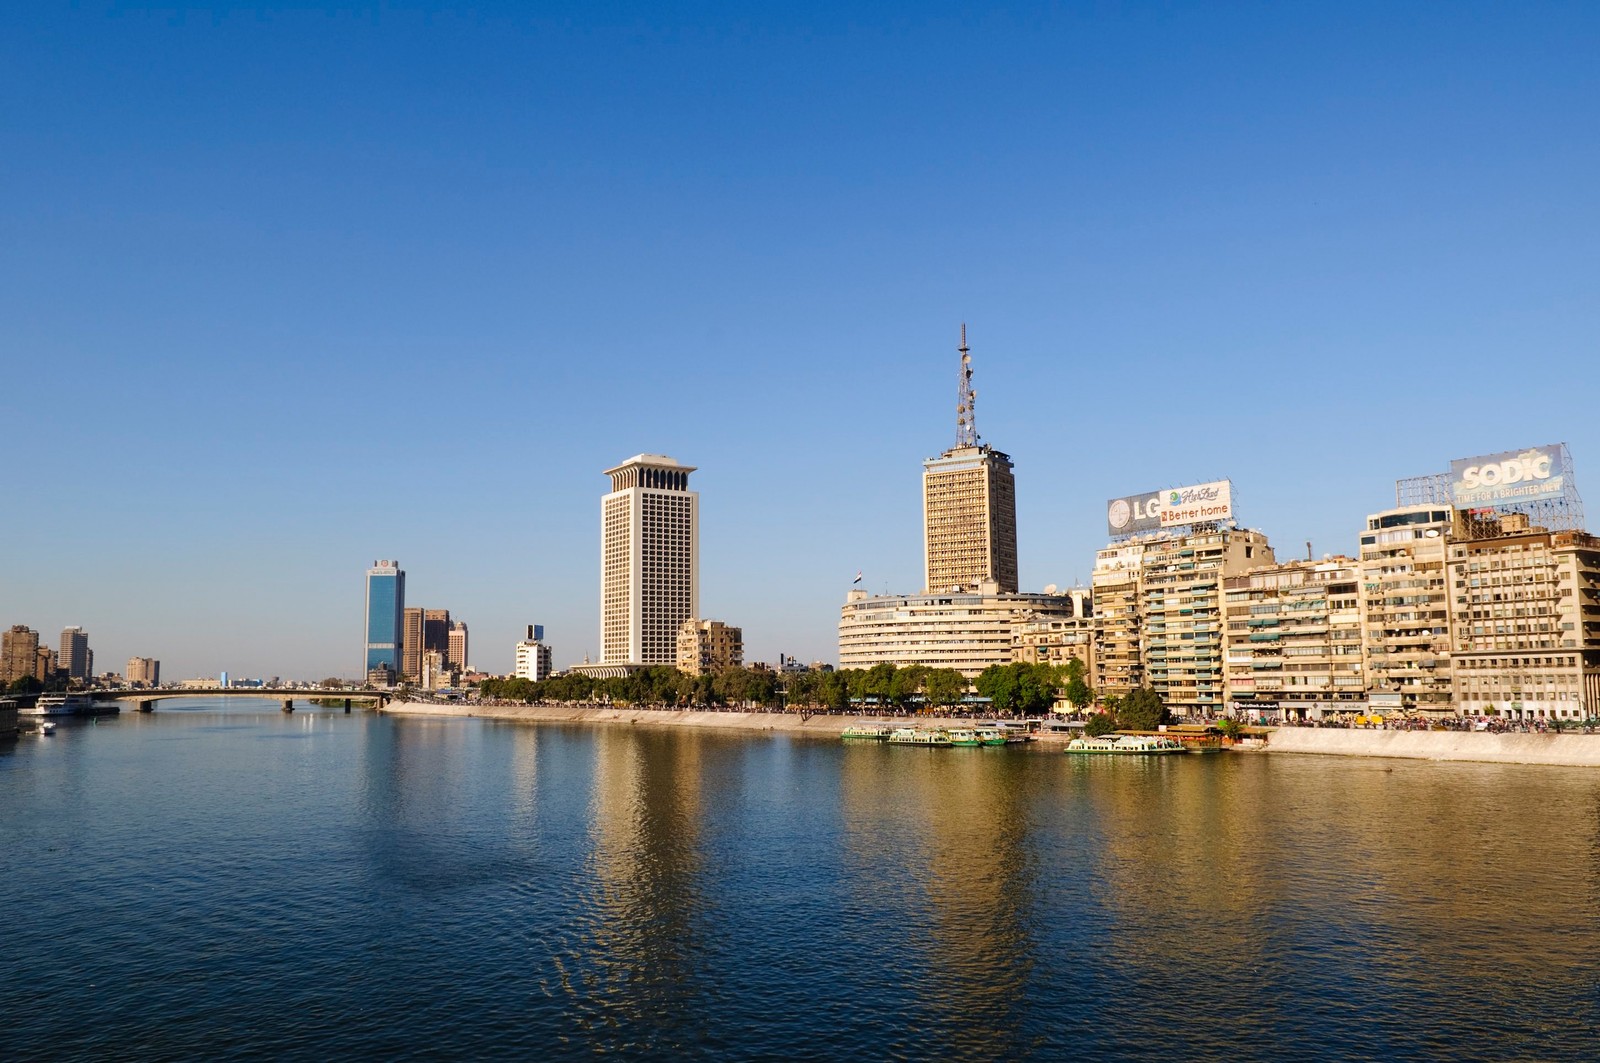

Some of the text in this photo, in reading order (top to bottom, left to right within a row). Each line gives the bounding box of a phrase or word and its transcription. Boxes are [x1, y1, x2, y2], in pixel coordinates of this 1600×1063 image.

[1463, 456, 1550, 489] SODIC
[1457, 483, 1561, 504] TIME FOR A BRIGHTER VIEW
[1134, 498, 1160, 520] LG
[1169, 505, 1228, 521] Better home
